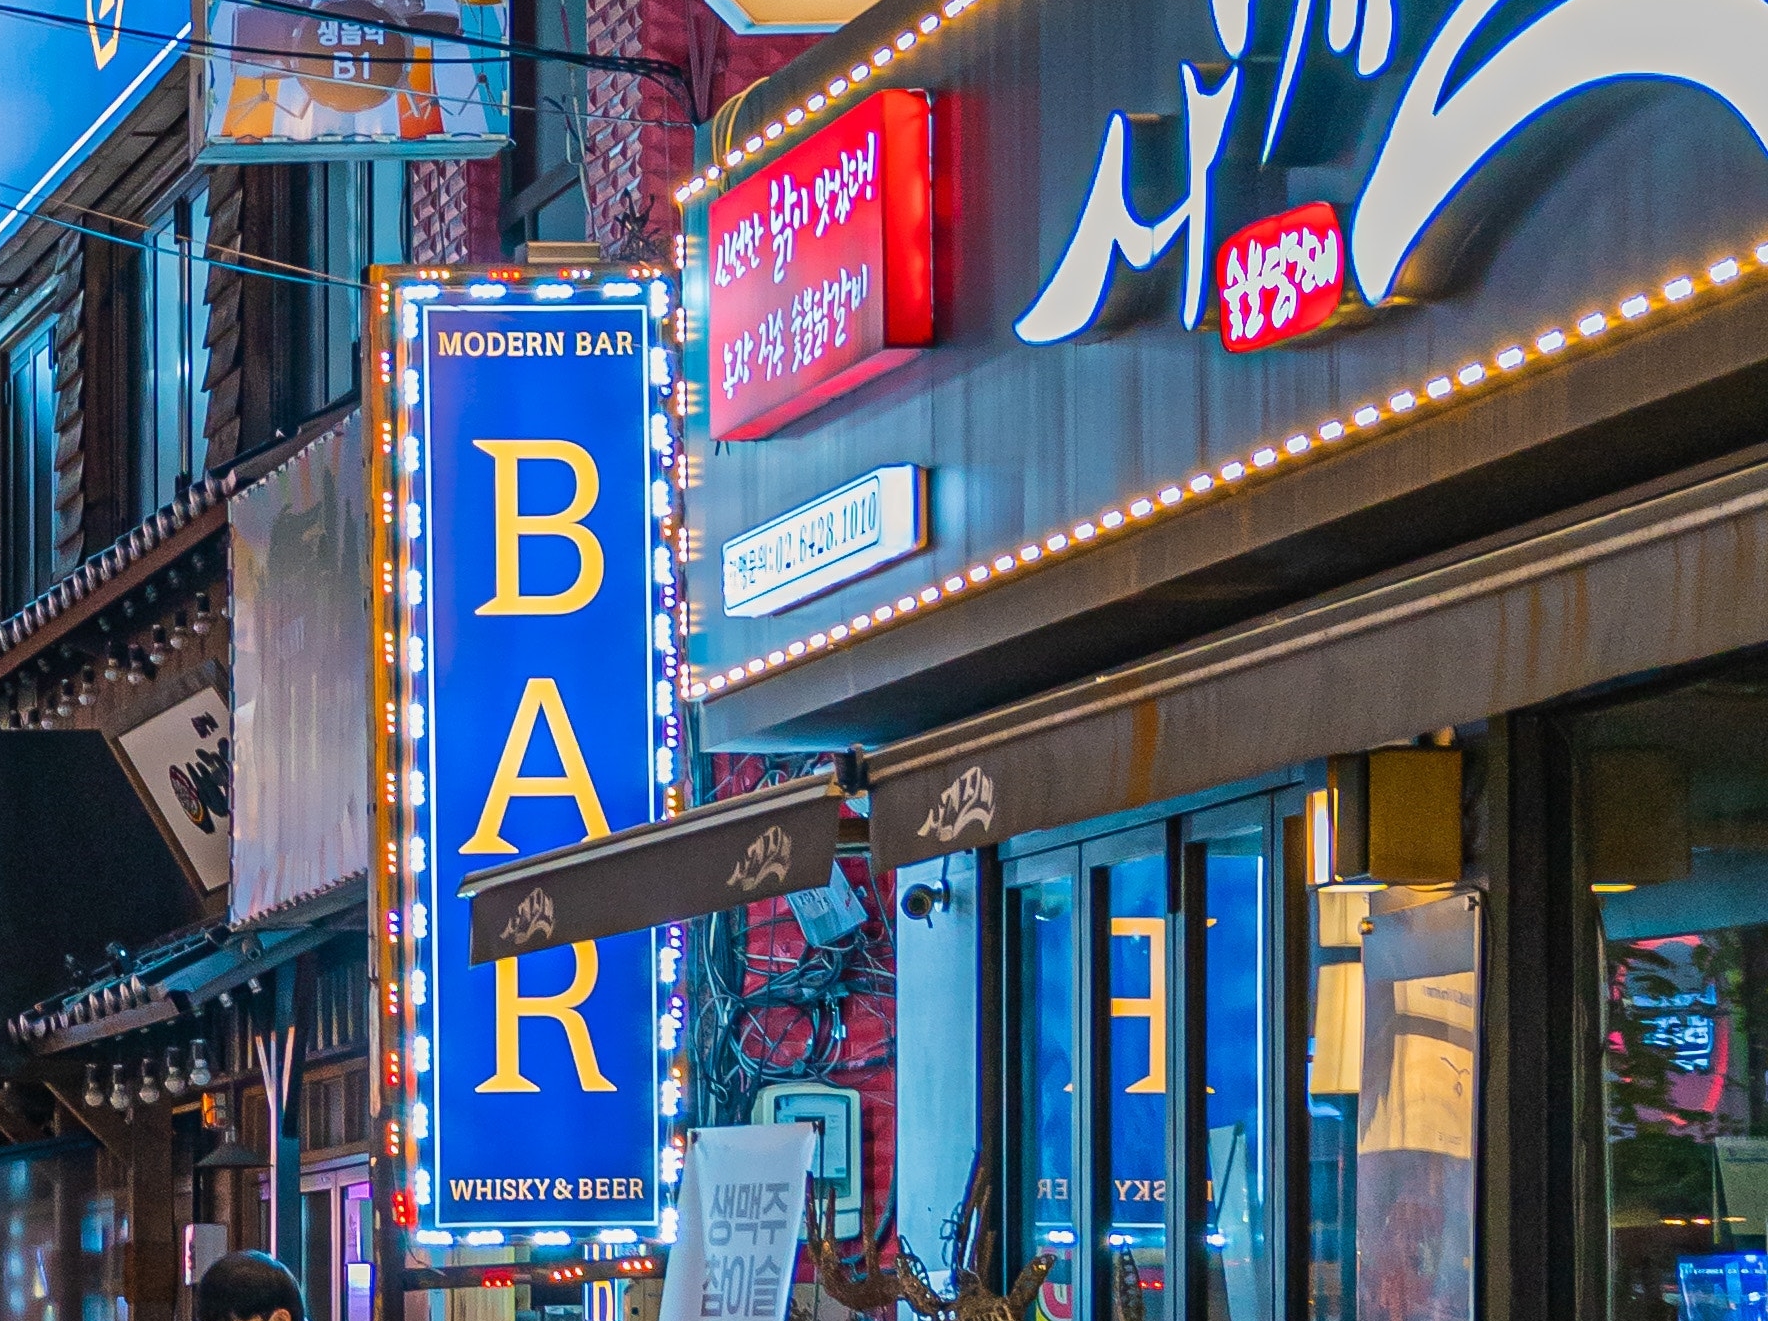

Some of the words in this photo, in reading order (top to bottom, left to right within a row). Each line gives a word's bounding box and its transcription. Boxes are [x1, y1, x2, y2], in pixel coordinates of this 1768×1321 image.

[332, 51, 371, 80] B1
[436, 329, 565, 357] MODERN
[574, 329, 633, 357] BAR
[459, 439, 619, 1092] BAR
[708, 1180, 789, 1245] 생맥주
[700, 1256, 784, 1319] 참이슬
